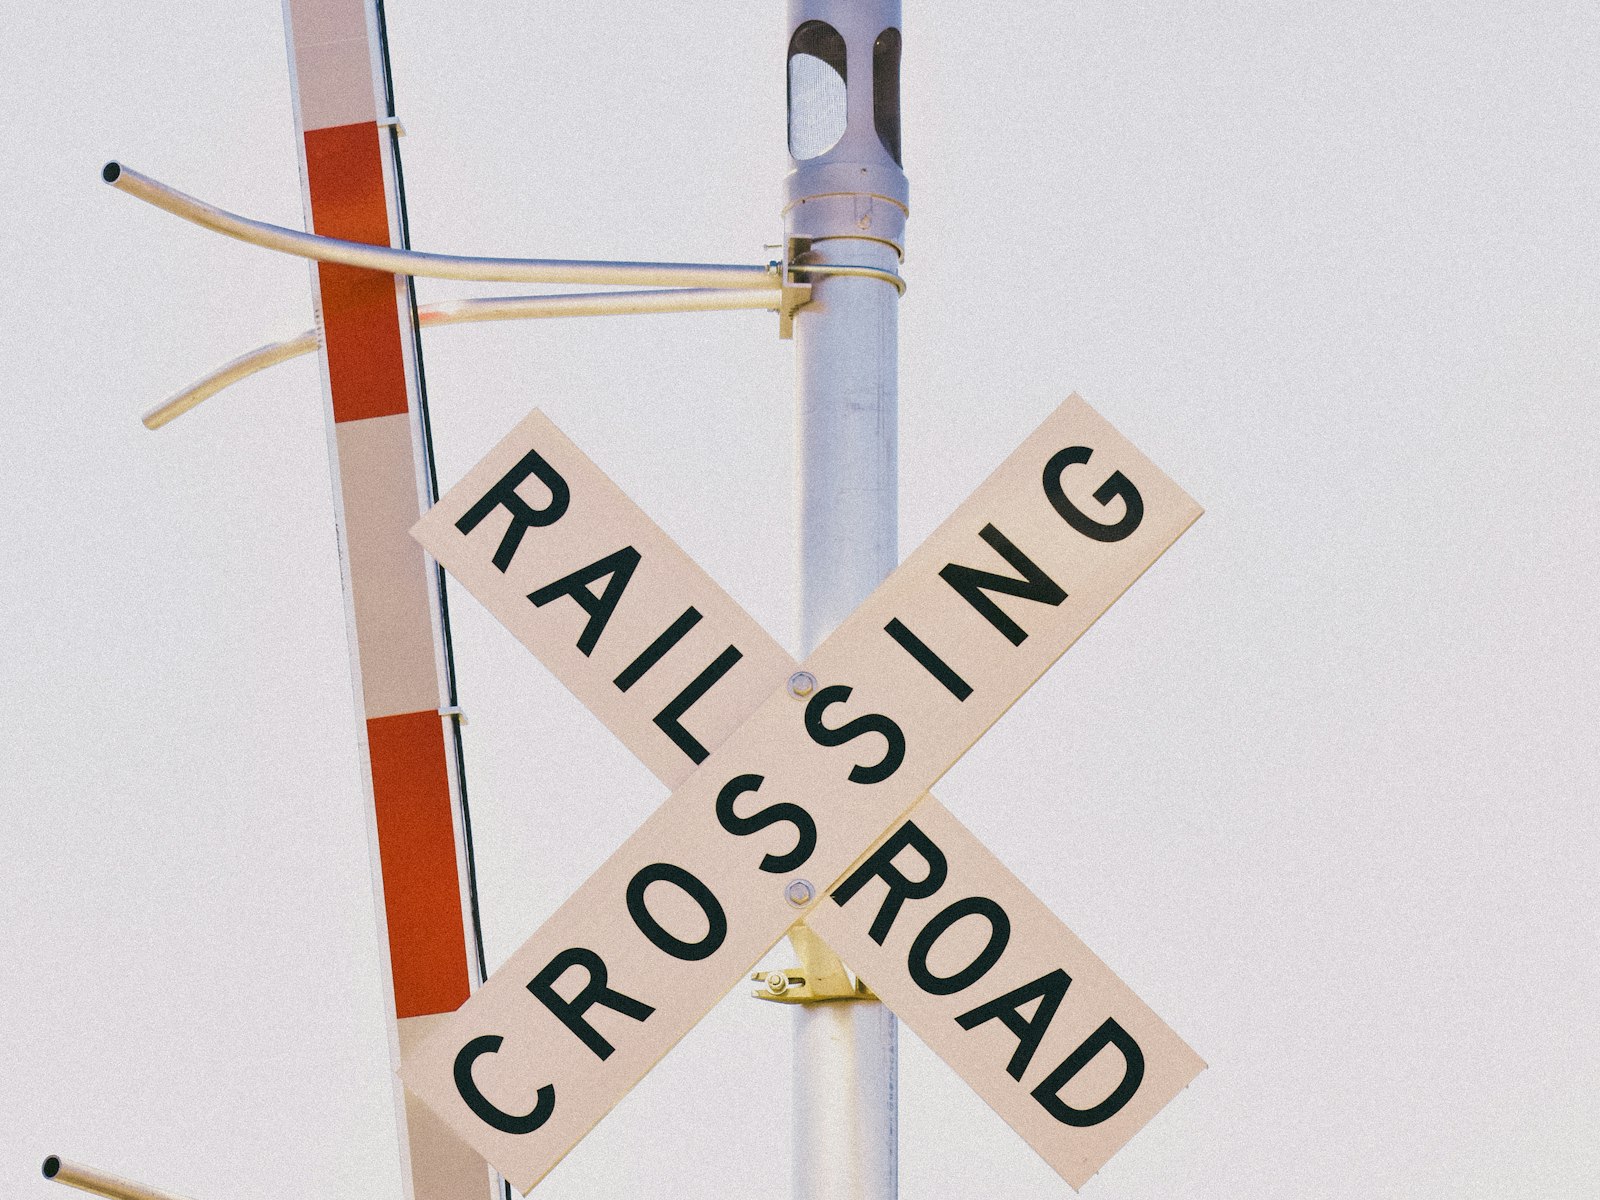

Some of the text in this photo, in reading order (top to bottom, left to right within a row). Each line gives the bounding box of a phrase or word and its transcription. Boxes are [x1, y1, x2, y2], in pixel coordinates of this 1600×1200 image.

[453, 445, 1144, 1135] CROSSING
[454, 448, 1145, 1128] RAIL ROAD
